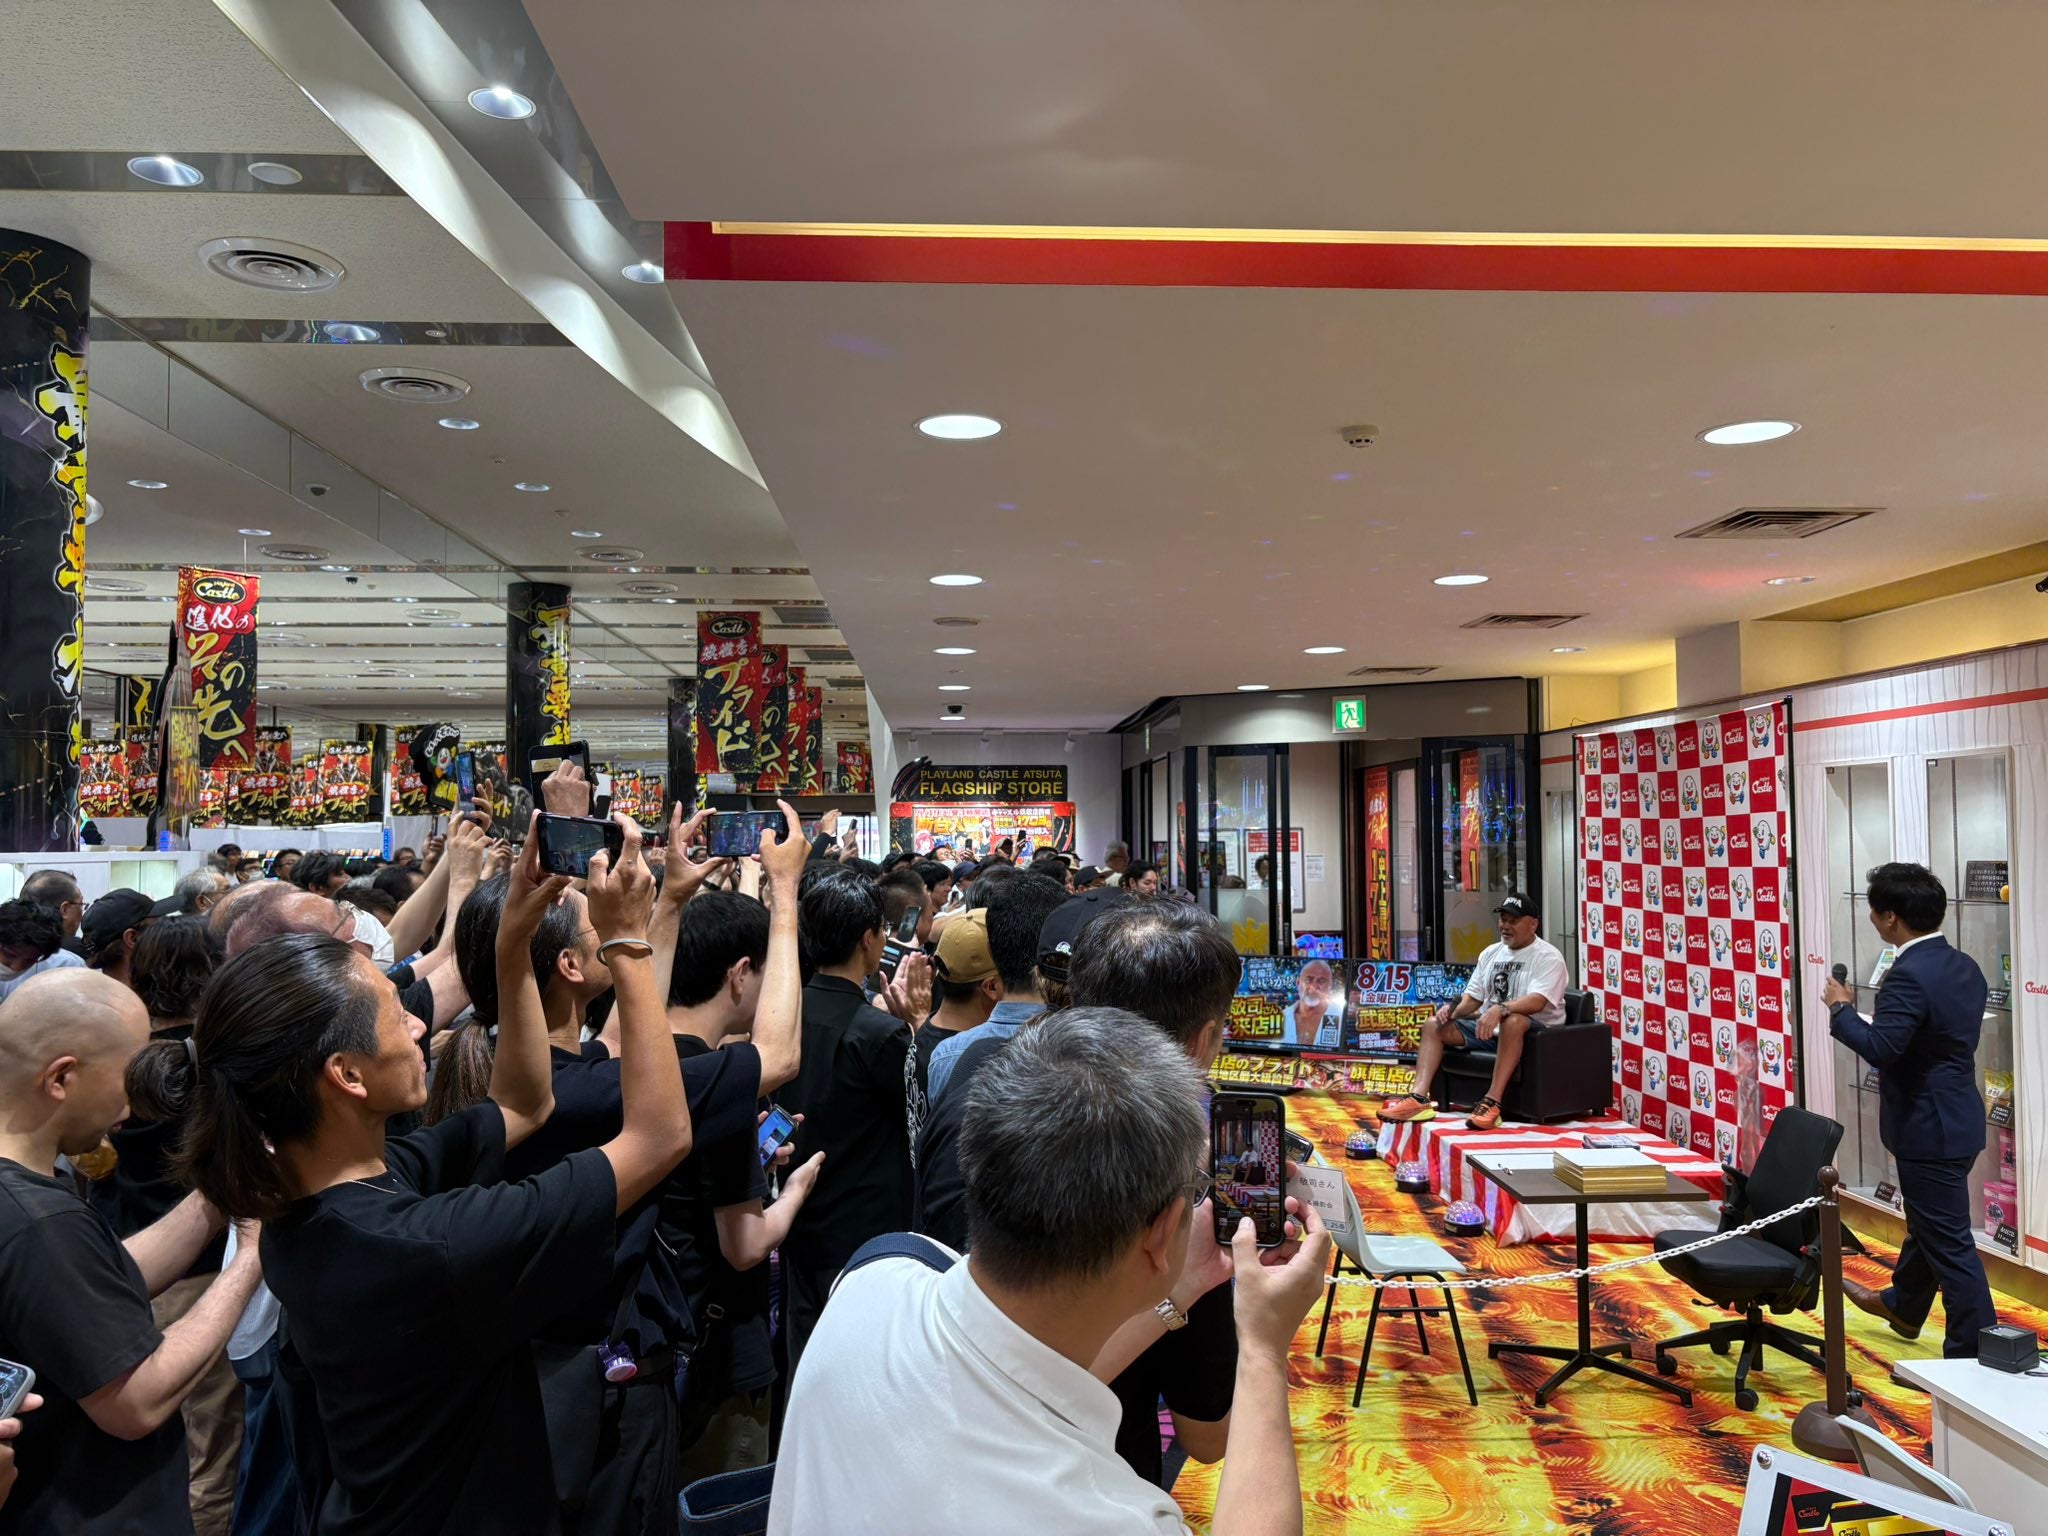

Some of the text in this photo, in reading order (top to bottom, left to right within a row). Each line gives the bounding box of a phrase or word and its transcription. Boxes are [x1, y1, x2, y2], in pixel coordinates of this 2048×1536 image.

[195, 581, 241, 601] Castle
[710, 621, 747, 635] Castle
[704, 657, 751, 773] プライド
[920, 770, 1062, 779] PLAYLAND CASTLE ATSUTA
[920, 782, 1063, 795] FLAGSHIP STORE
[1357, 963, 1411, 992] 8/15
[1358, 1007, 1430, 1029] 武藤敬司
[1299, 1177, 1336, 1190] 敬司さん
